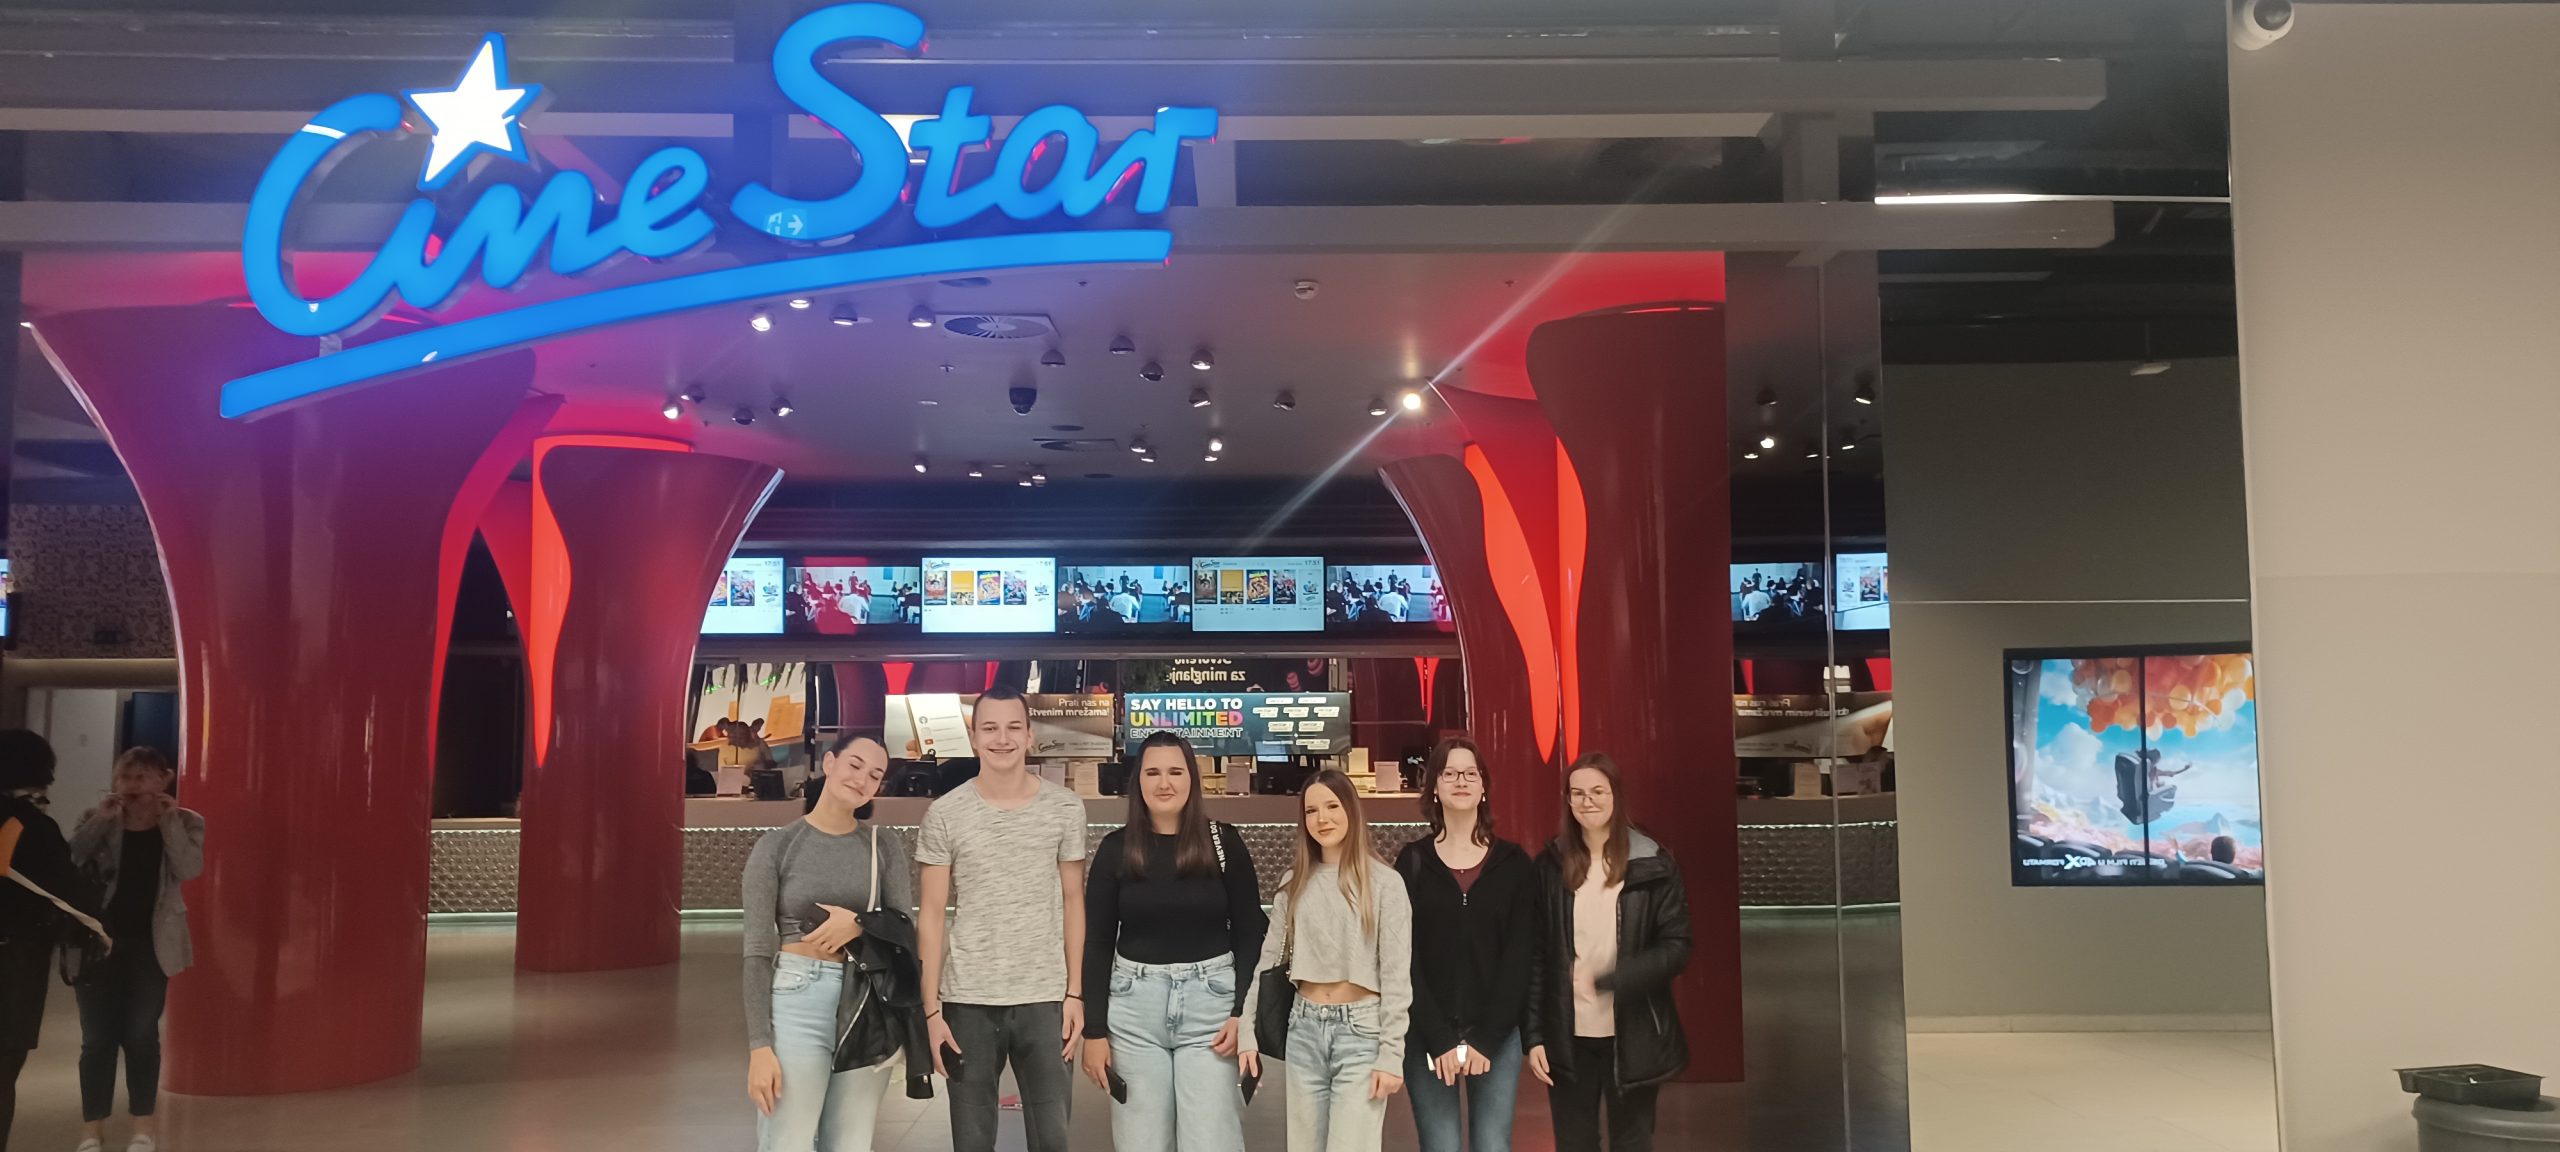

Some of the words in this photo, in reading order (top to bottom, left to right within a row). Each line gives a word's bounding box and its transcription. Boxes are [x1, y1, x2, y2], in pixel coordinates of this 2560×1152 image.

[1058, 698, 1079, 707] Prati
[1130, 698, 1162, 711] SAY
[1165, 698, 1217, 711] HELLO
[1220, 697, 1243, 710] TO
[1065, 707, 1110, 717] mrežama!
[1130, 710, 1244, 727] UNLIMITED
[1129, 727, 1244, 739] ENTAINMENT
[1212, 834, 1226, 861] NEVER
